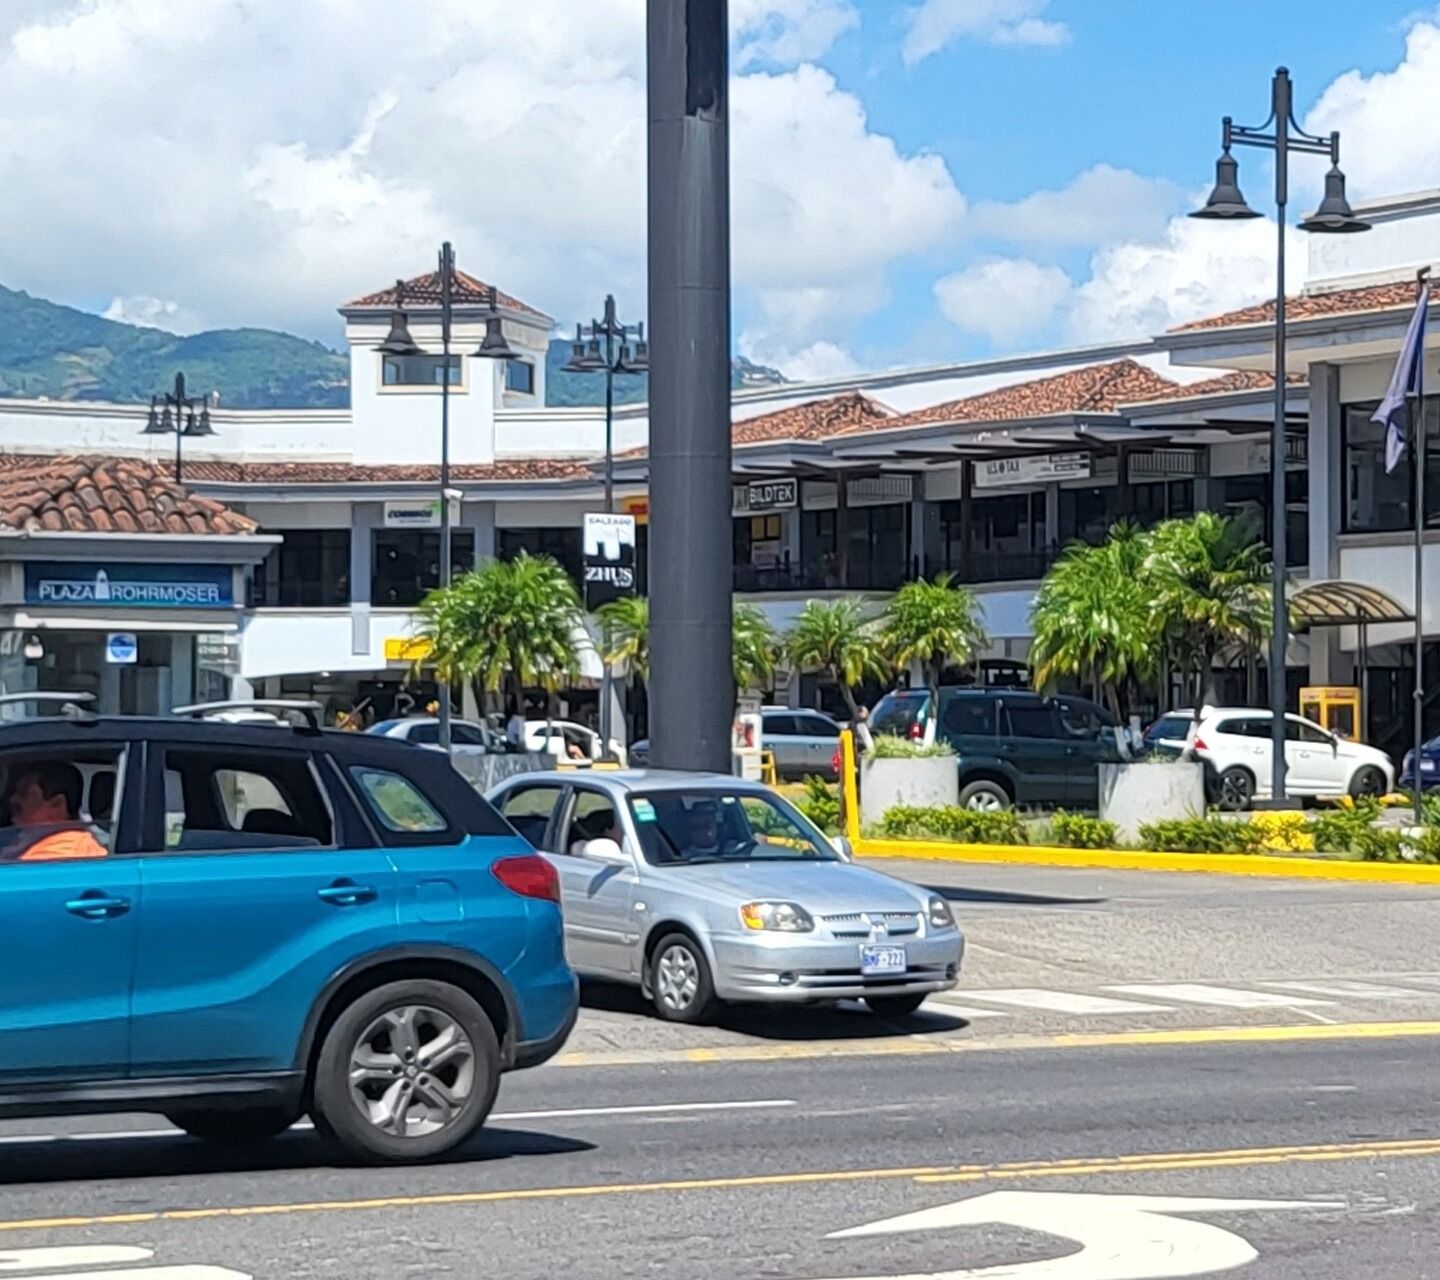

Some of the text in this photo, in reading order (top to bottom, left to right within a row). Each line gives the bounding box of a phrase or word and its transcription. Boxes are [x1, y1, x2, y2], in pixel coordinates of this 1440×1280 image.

[750, 484, 793, 504] BILDTEK
[39, 585, 219, 602] PLAZA ROHRMOSER
